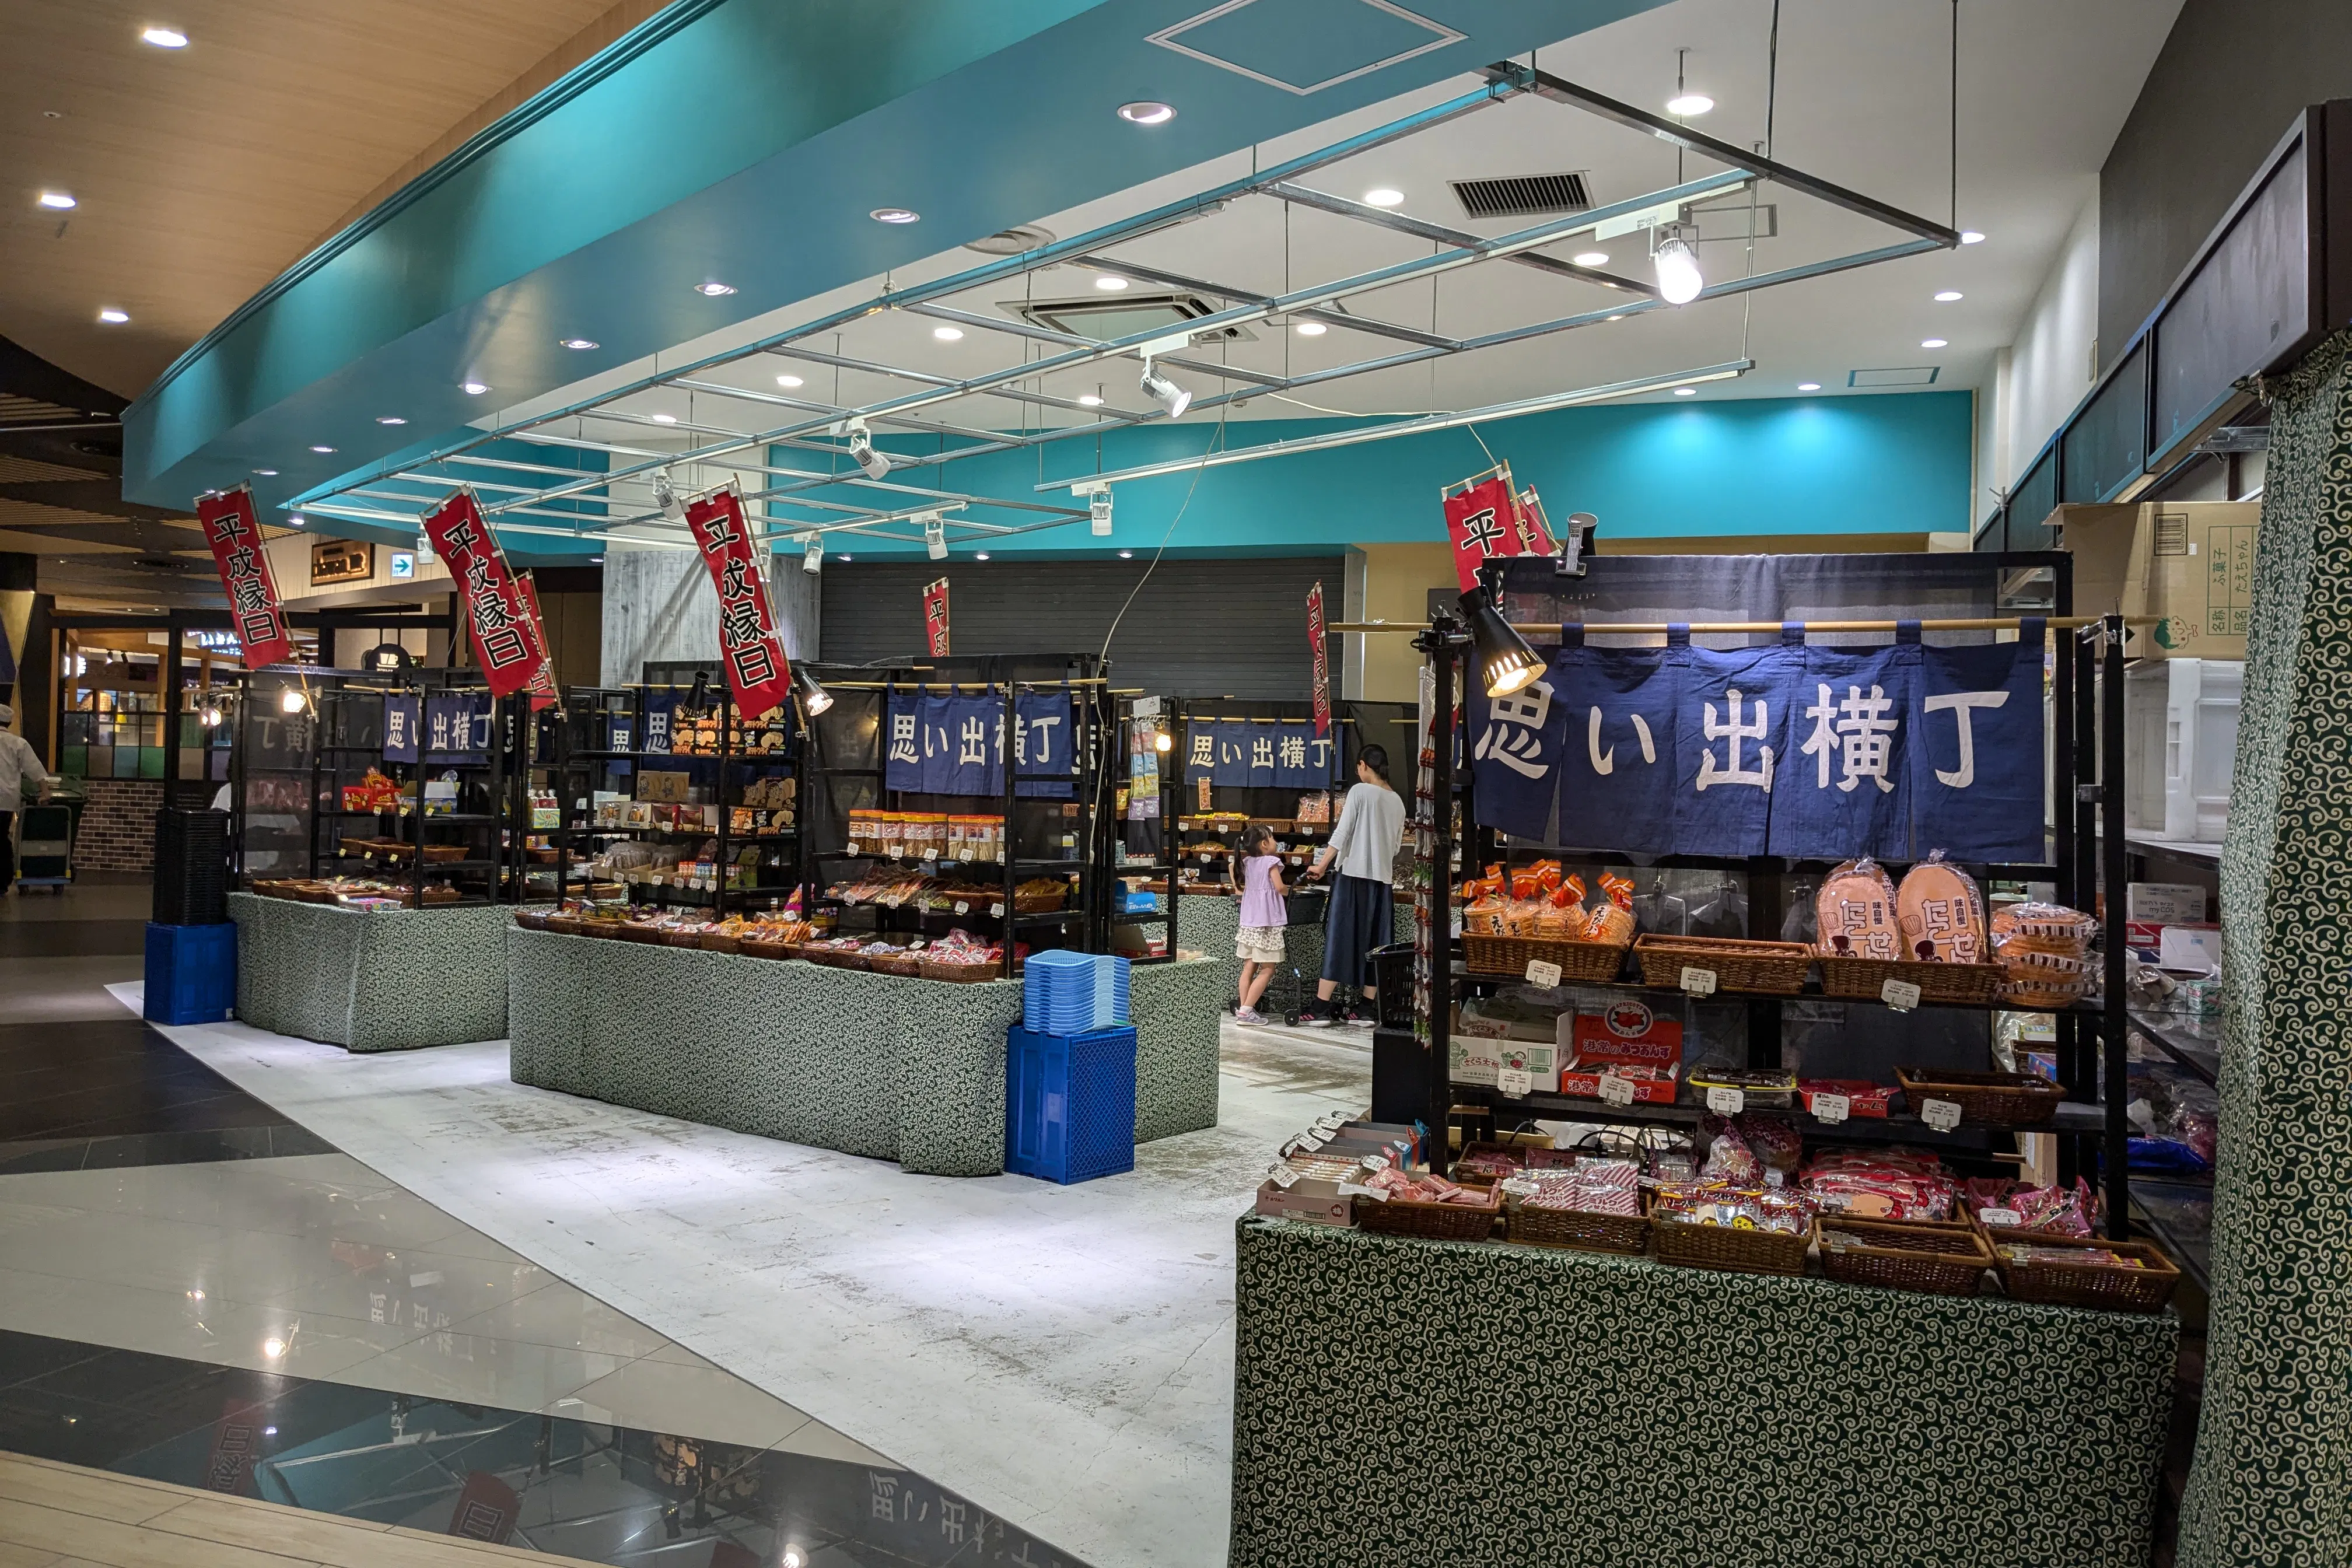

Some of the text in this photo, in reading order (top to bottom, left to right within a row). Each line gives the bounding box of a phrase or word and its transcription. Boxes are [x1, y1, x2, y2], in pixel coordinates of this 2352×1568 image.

[213, 512, 279, 646] 平成縁日
[2213, 547, 2227, 586] ふ菓子
[2234, 540, 2248, 593] たえちゃん
[443, 519, 528, 669] 平成縁日
[704, 514, 777, 689] 平成縁日
[2212, 610, 2227, 632] 名称
[2234, 610, 2248, 632] 品名
[645, 712, 670, 754] 思
[890, 713, 1061, 766] 思い出横丁
[1474, 681, 2010, 793] 思い出横丁
[1189, 734, 1331, 769] 思い出横丁
[1581, 907, 1605, 940] えび小丸
[1872, 901, 1884, 926] 味自慢
[1954, 898, 1967, 926] 味自慢
[1616, 1002, 1644, 1010] APRICOTS
[1464, 1058, 1500, 1069] さくら大根
[1583, 1038, 1672, 1059] 港常のみつあんず
[1587, 1196, 1618, 1206] ミルク
[1593, 1205, 1623, 1213] せんべい
